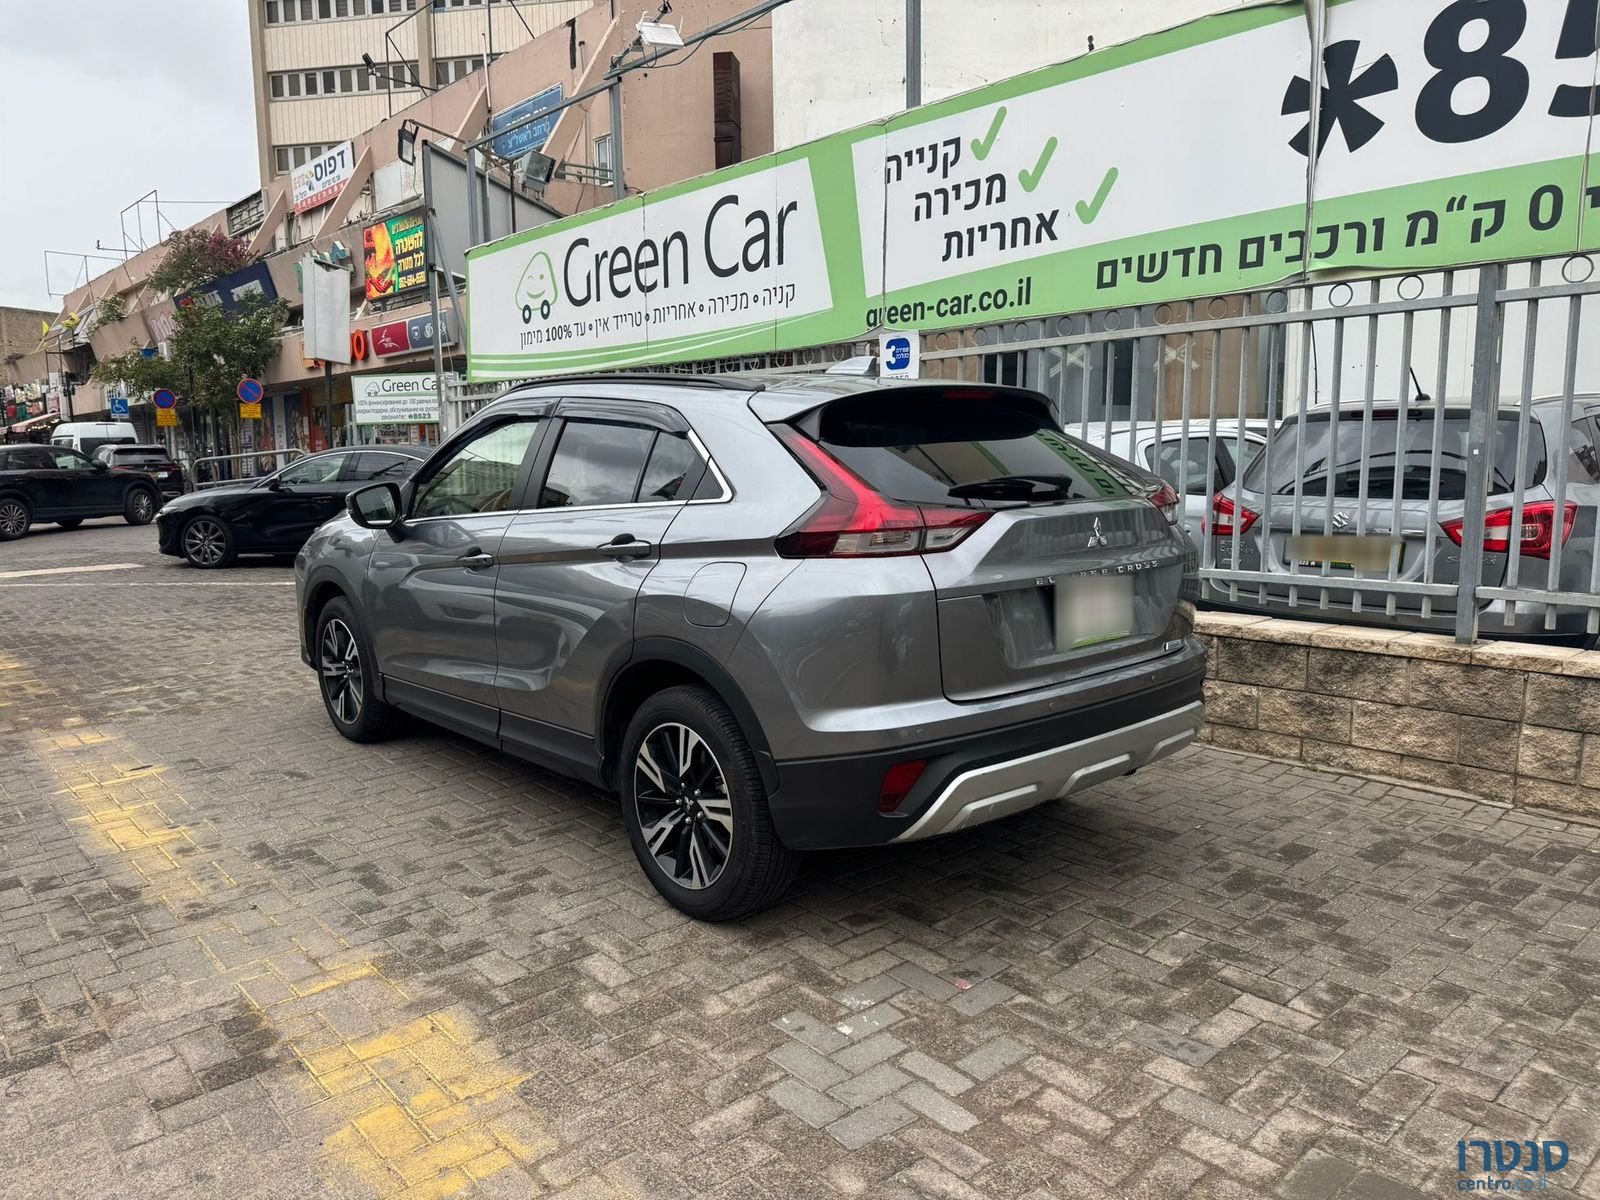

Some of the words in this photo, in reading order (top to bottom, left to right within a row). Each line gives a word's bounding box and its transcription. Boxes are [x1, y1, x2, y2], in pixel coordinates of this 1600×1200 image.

[313, 149, 346, 182] דפוס
[886, 136, 961, 184] קנייה
[914, 173, 1007, 222] מכירה
[1528, 184, 1564, 231] 0
[942, 209, 1060, 262] אחריות
[1238, 217, 1386, 270] ורכבים
[563, 230, 689, 307] Green
[704, 194, 798, 278] Car
[1096, 243, 1223, 290] חדשים
[708, 292, 749, 315] מכירה
[762, 283, 796, 308] קניה
[866, 276, 1032, 331] green-car.co.il
[612, 310, 643, 331] טרייד
[653, 301, 697, 325] אחריות
[520, 328, 543, 350] מימון
[545, 324, 573, 342] 100%
[573, 321, 587, 337] עד
[594, 315, 610, 338] אין
[381, 378, 420, 393] Green
[421, 377, 438, 392] Ca
[1117, 560, 1158, 574] CROSS
